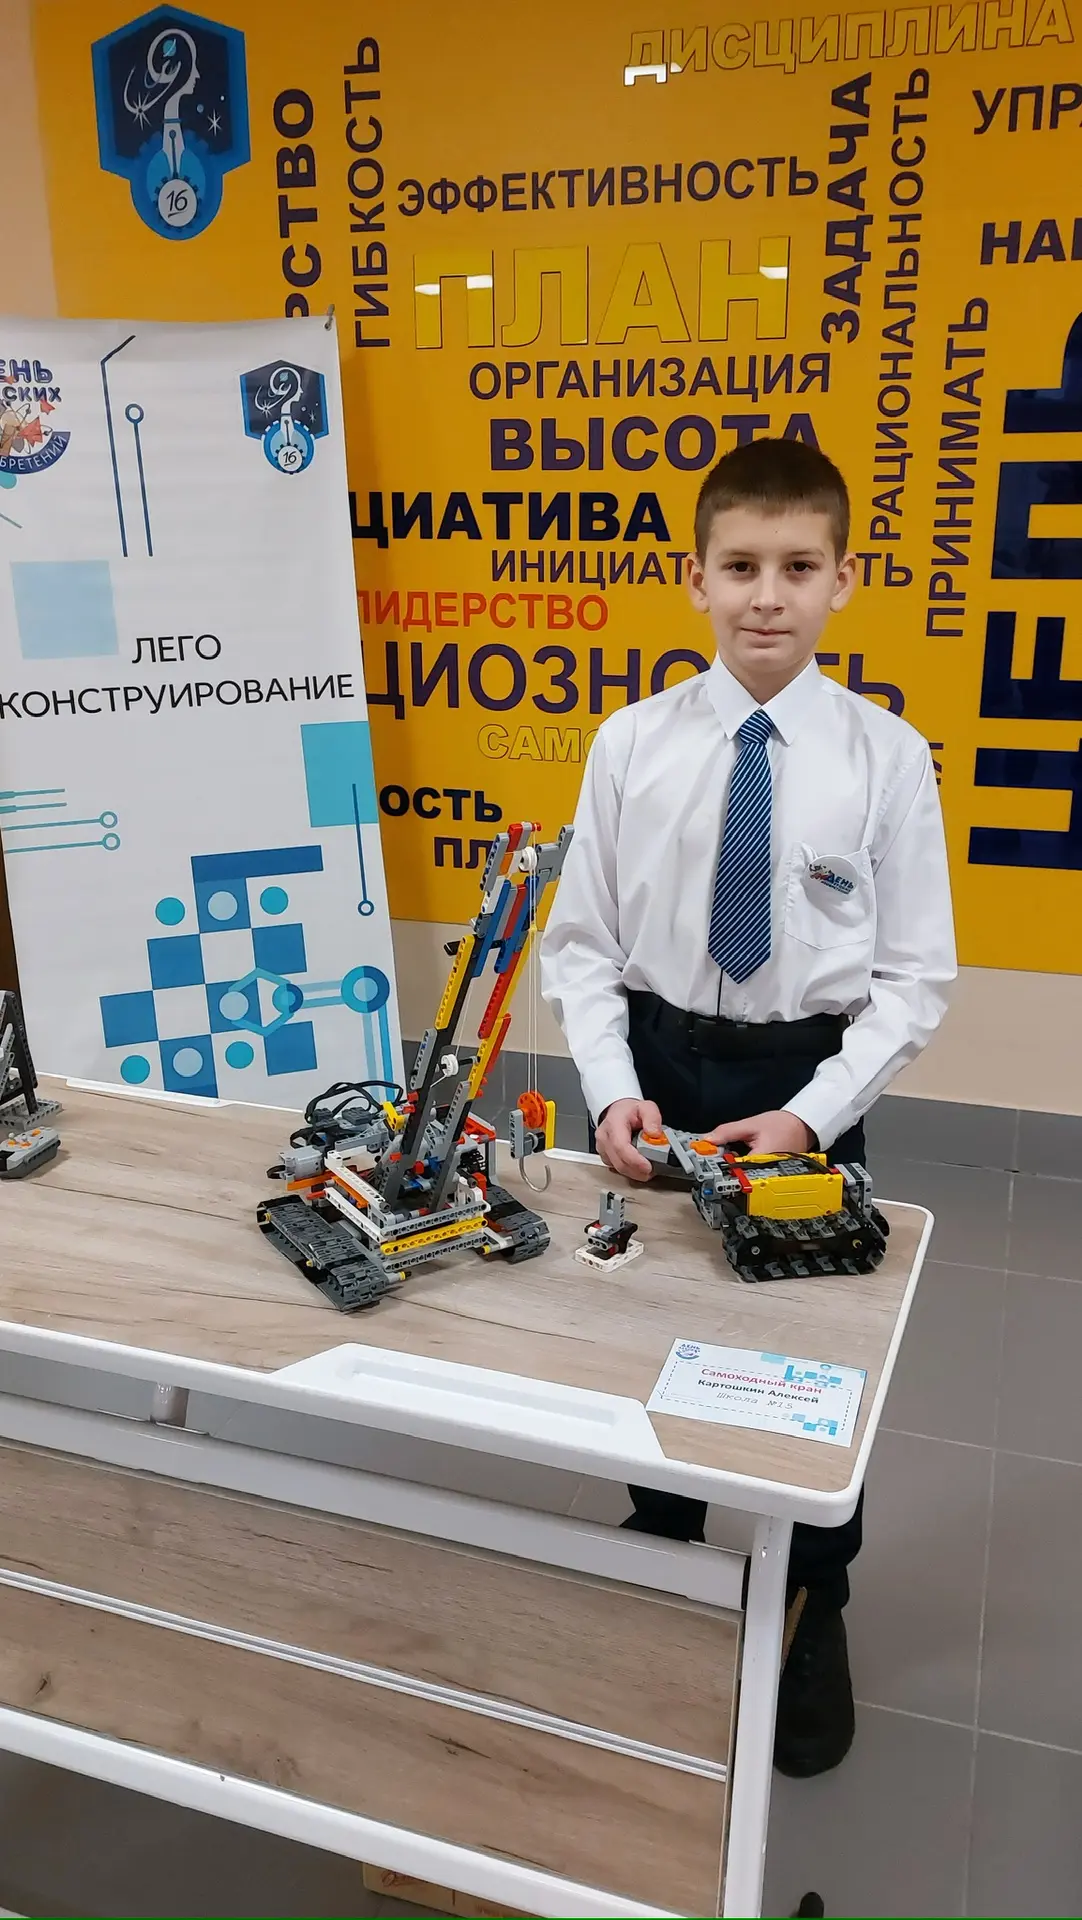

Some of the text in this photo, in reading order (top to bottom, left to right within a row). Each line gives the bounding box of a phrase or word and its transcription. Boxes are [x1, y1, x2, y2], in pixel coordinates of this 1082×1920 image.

[624, 0, 1073, 86] ДИСЦИПЛИНА
[972, 83, 1082, 135] УПР
[166, 188, 189, 212] 16
[343, 36, 391, 348] ГИБКОСТЬ
[397, 155, 819, 217] ЭФФЕКТИВНОСТЬ
[820, 71, 873, 344] ЗАДАЧА
[413, 236, 791, 351] ПЛАН
[870, 67, 930, 541] РАЦИОНАЛЬНОСТЬ
[468, 352, 831, 403] ОРГАНИЗАЦИЯ
[282, 450, 297, 464] 16
[925, 297, 989, 638] ПРИНИМАТЬ
[348, 490, 672, 549] ЦИАТИВА
[131, 634, 222, 664] ЛЕГО
[0, 673, 355, 720] КОНСТРУИРОВАНИЕ
[477, 723, 600, 763] САМ
[697, 1379, 819, 1404] Картошкин Алексей
[701, 1368, 823, 1394] Самоходный кран
[716, 1391, 759, 1404] Школа
